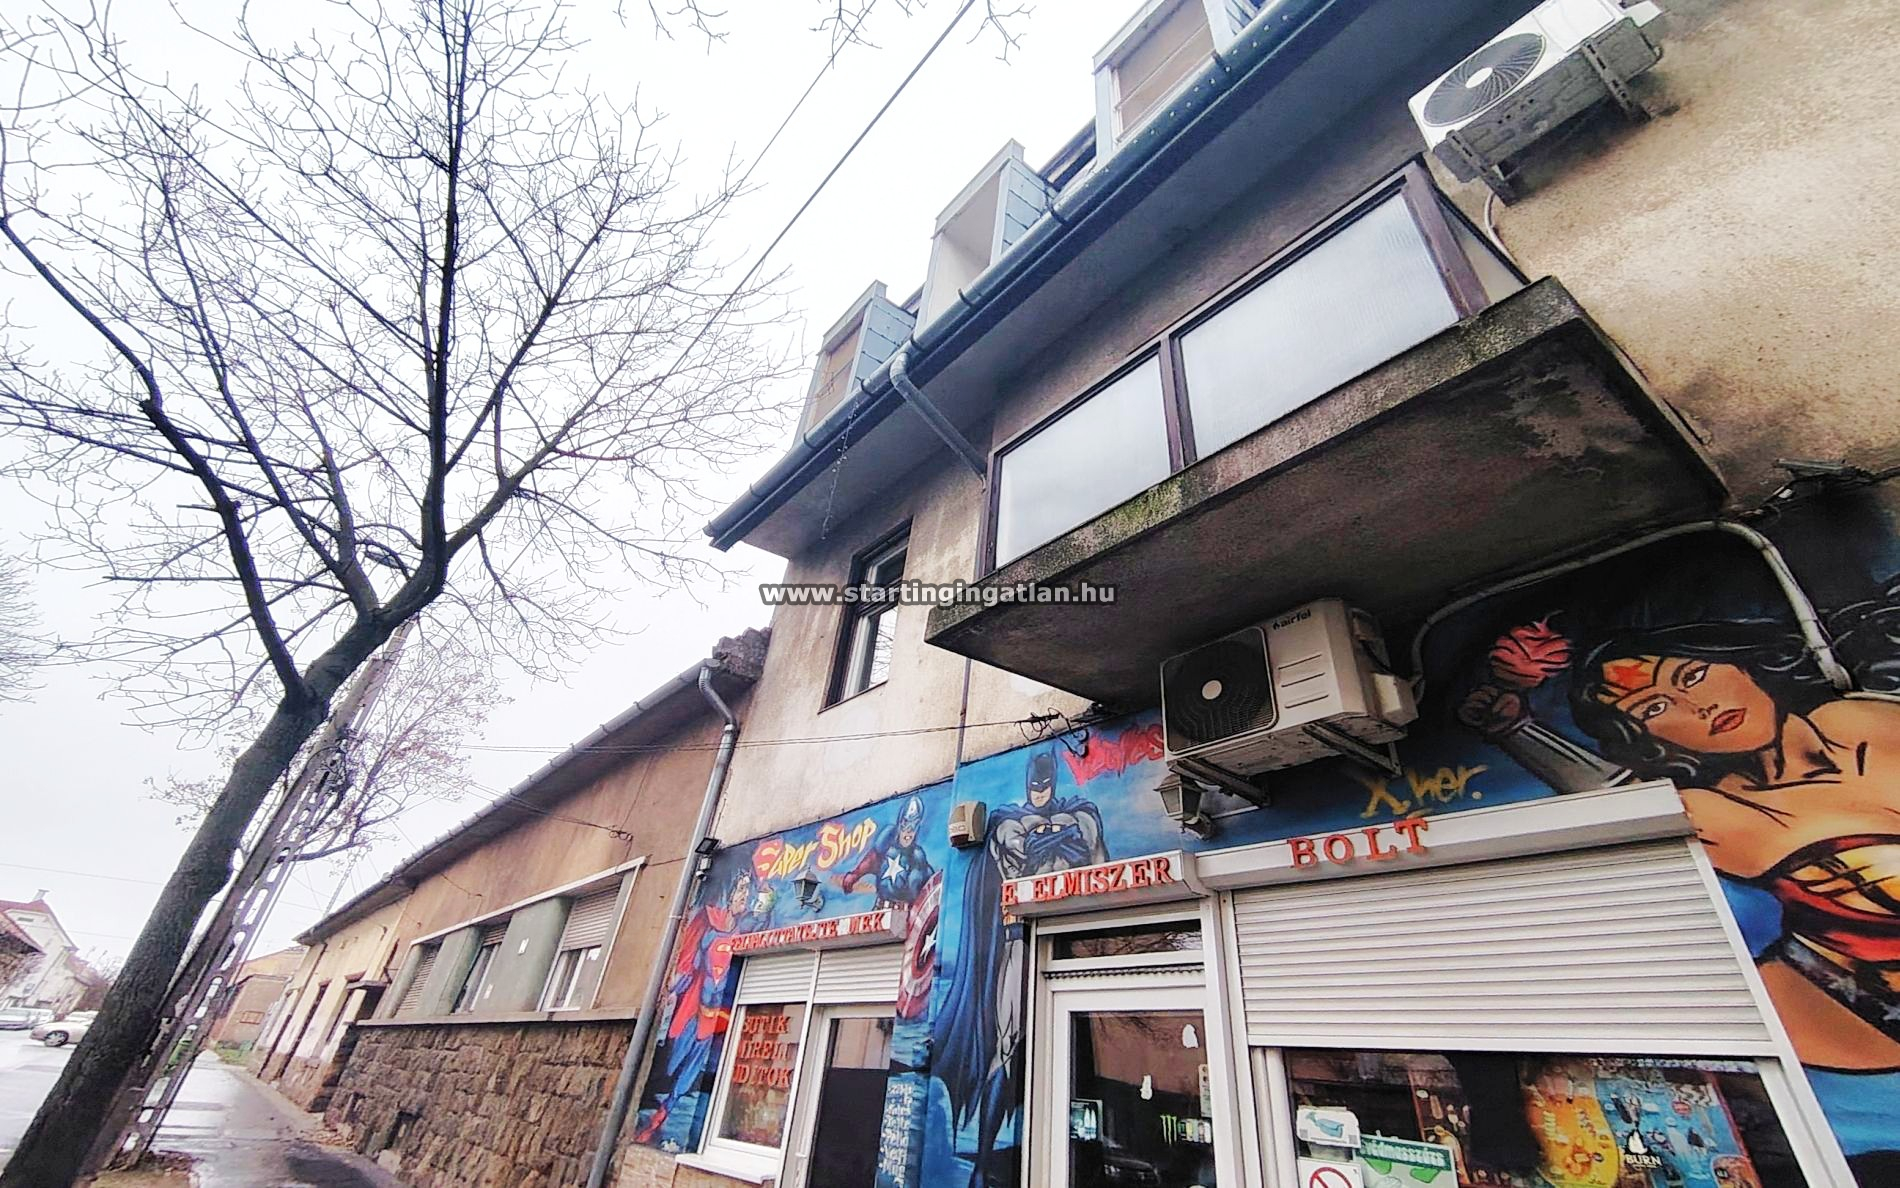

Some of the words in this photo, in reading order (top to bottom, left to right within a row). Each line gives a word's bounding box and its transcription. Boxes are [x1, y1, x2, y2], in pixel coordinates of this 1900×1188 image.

[1287, 817, 1429, 869] BOLT
[1031, 857, 1176, 902] ELMISZER
[1624, 1154, 1663, 1167] BURN
